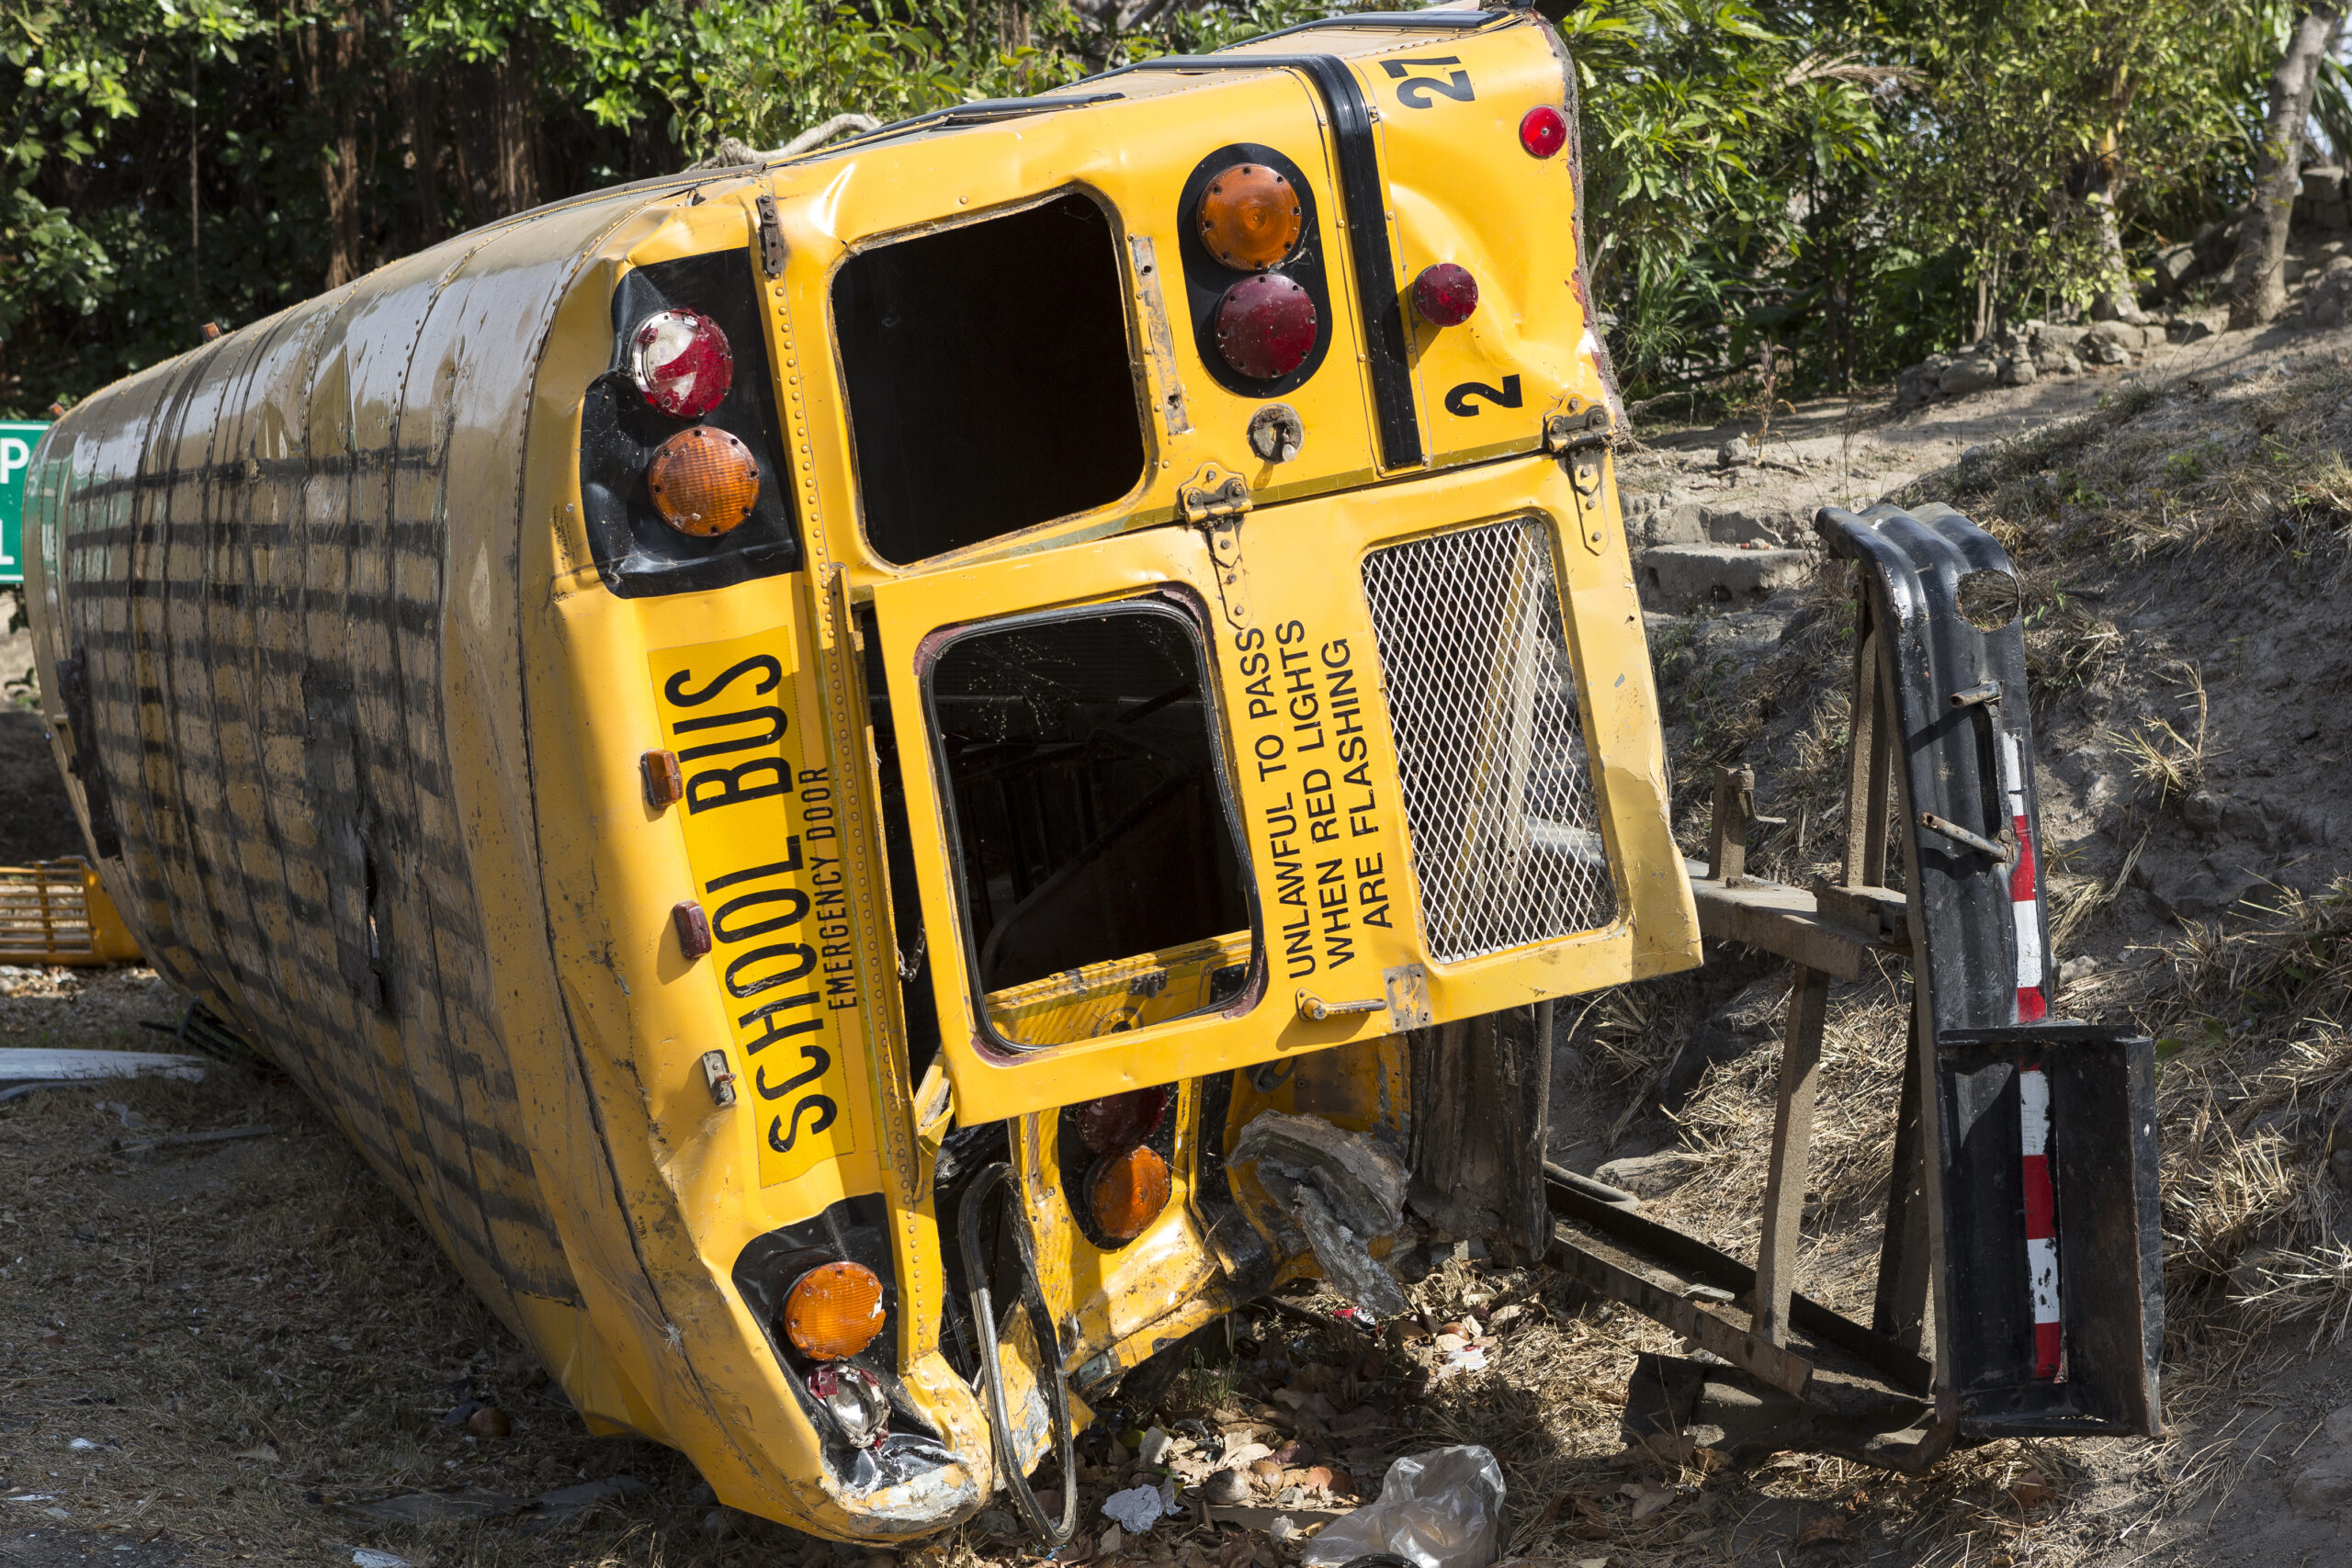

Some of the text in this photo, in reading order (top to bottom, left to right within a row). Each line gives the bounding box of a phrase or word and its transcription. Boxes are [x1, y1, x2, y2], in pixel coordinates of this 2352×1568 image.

[1379, 56, 1475, 109] 27
[1444, 373, 1523, 418] 2
[664, 653, 837, 1154] SCHOOL BUS
[798, 766, 857, 1010] EMERGENCY DOOR
[1236, 627, 1316, 979] UNLAWFUL TO PASS
[1276, 620, 1354, 970] WHEN RED LIGHTS
[1321, 638, 1393, 929] ARE FLASHING
